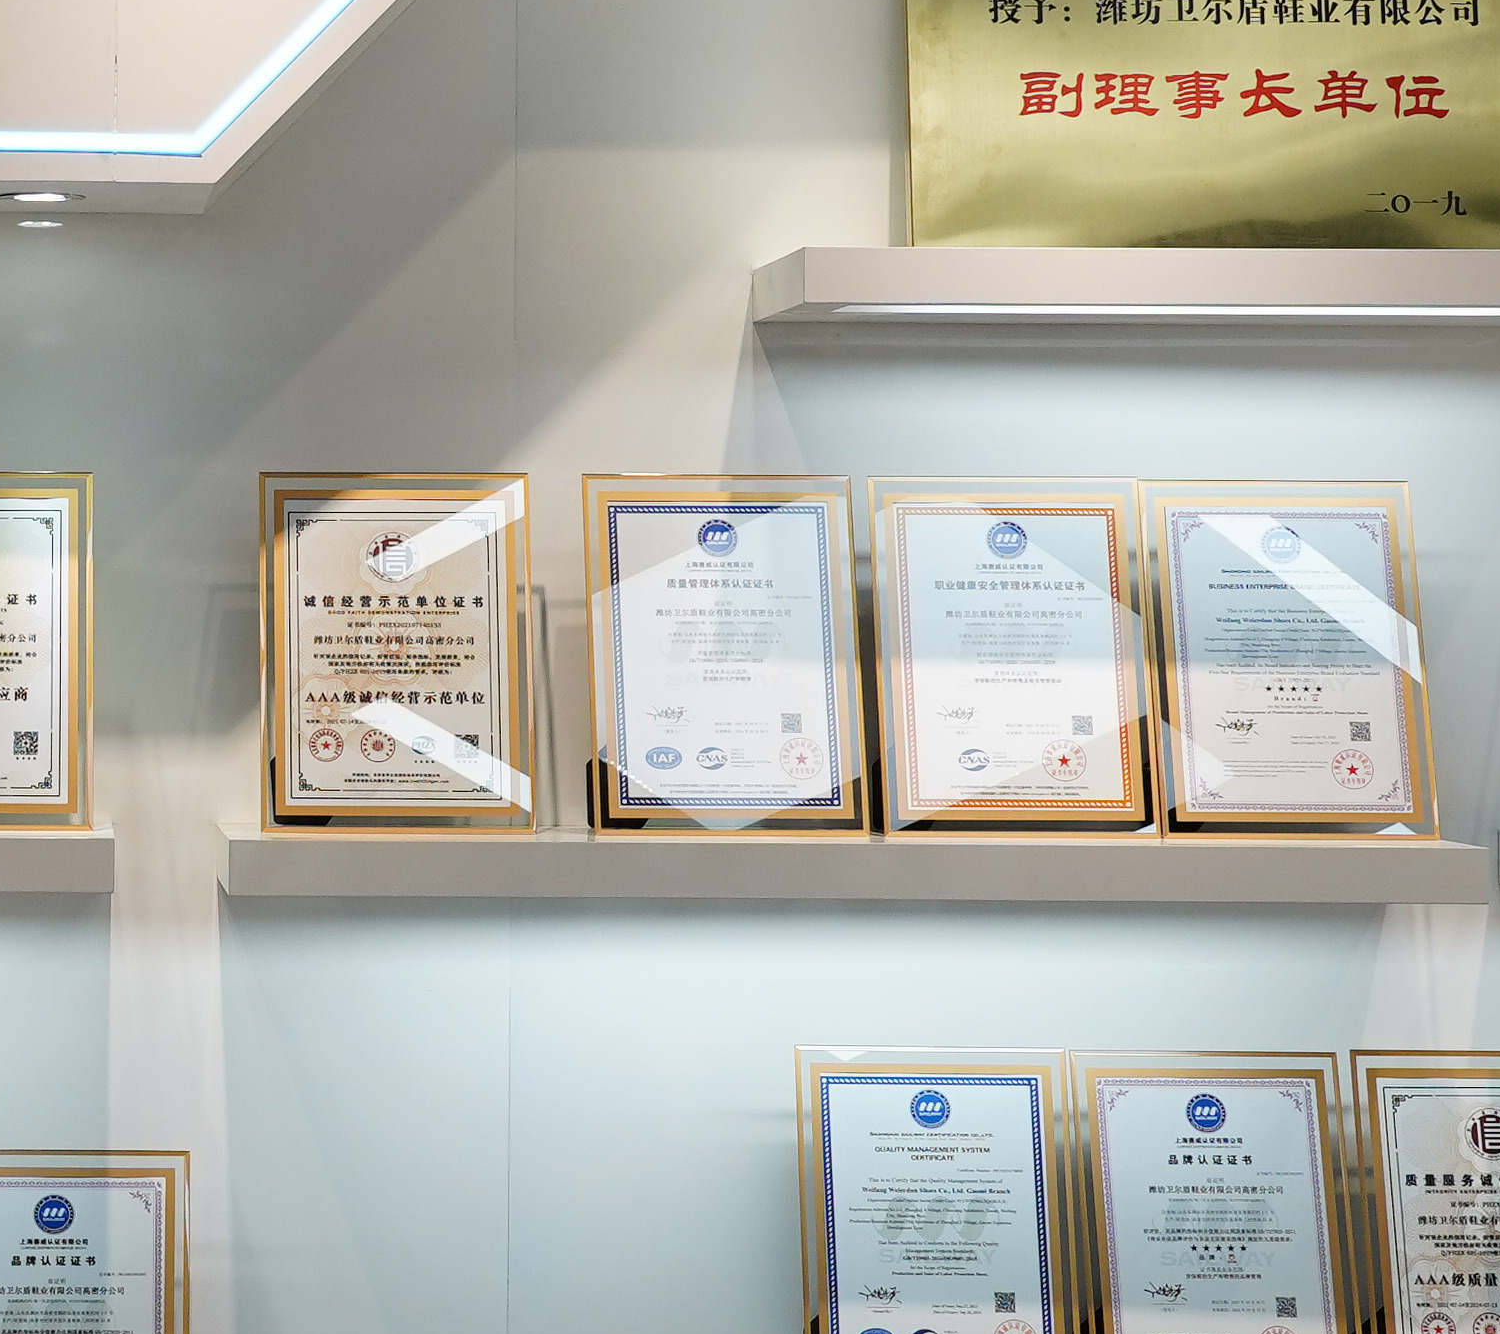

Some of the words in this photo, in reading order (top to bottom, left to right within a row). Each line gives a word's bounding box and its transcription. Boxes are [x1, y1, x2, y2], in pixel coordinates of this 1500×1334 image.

[1019, 69, 1450, 119] 副理事长单位
[304, 595, 484, 608] 诚信经营示范单位证书
[305, 690, 486, 705] AAA级诚信经营示范单位
[652, 752, 676, 763] IAF
[696, 752, 728, 763] CNAS
[958, 754, 990, 765] CNAS
[1168, 1154, 1253, 1165] 品牌认证证书
[11, 1255, 96, 1266] 品牌认证证书
